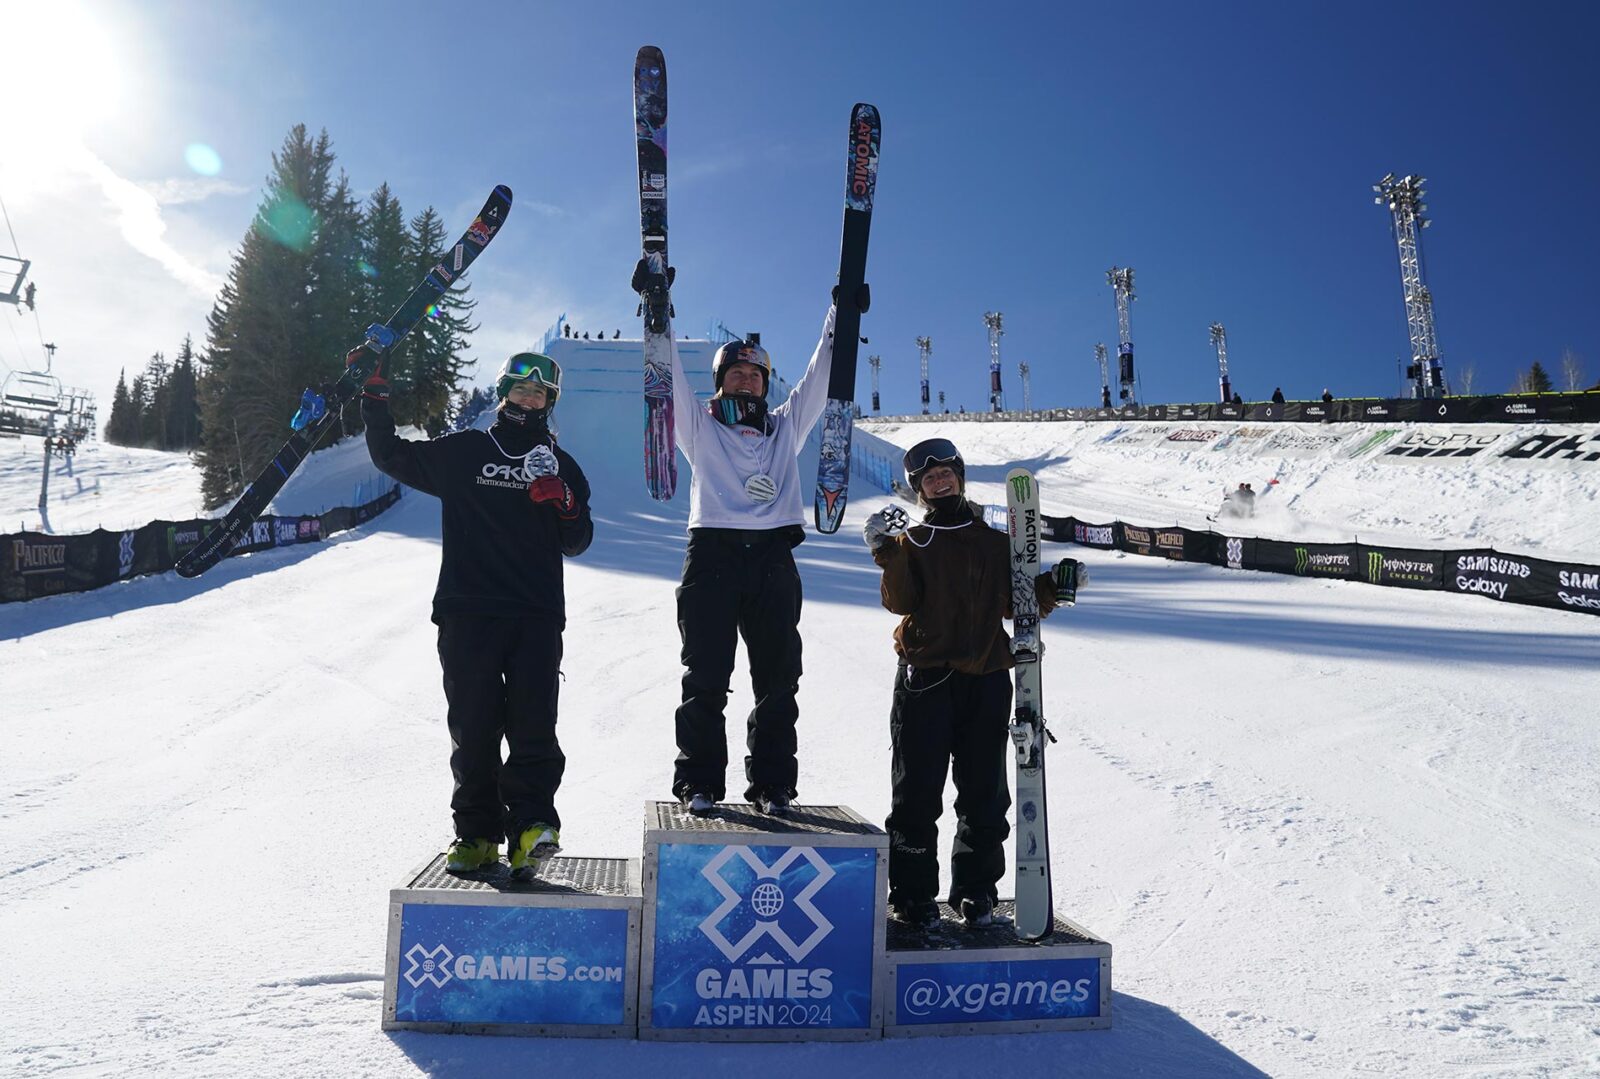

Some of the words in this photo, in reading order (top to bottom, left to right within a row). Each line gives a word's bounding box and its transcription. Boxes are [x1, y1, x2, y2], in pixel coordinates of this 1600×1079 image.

[853, 121, 872, 196] ATOMIC
[475, 476, 526, 490] Thermonuclear
[1009, 514, 1017, 538] Sunrise
[1024, 508, 1037, 564] FACTION
[200, 531, 231, 560] Nightstick
[1154, 530, 1184, 546] PACIFICO
[1308, 553, 1350, 566] MONSTER
[1382, 558, 1434, 574] MONSTER
[1457, 556, 1531, 578] SAMSUNG
[1389, 572, 1425, 581] ENERGY
[1456, 575, 1508, 599] Galaxy
[1558, 570, 1600, 590] SAM
[1557, 591, 1600, 609] Gala
[695, 968, 834, 999] GAMES
[904, 977, 1092, 1016] @xgames
[694, 1004, 775, 1026] ASPEN
[777, 1004, 833, 1026] 2024
